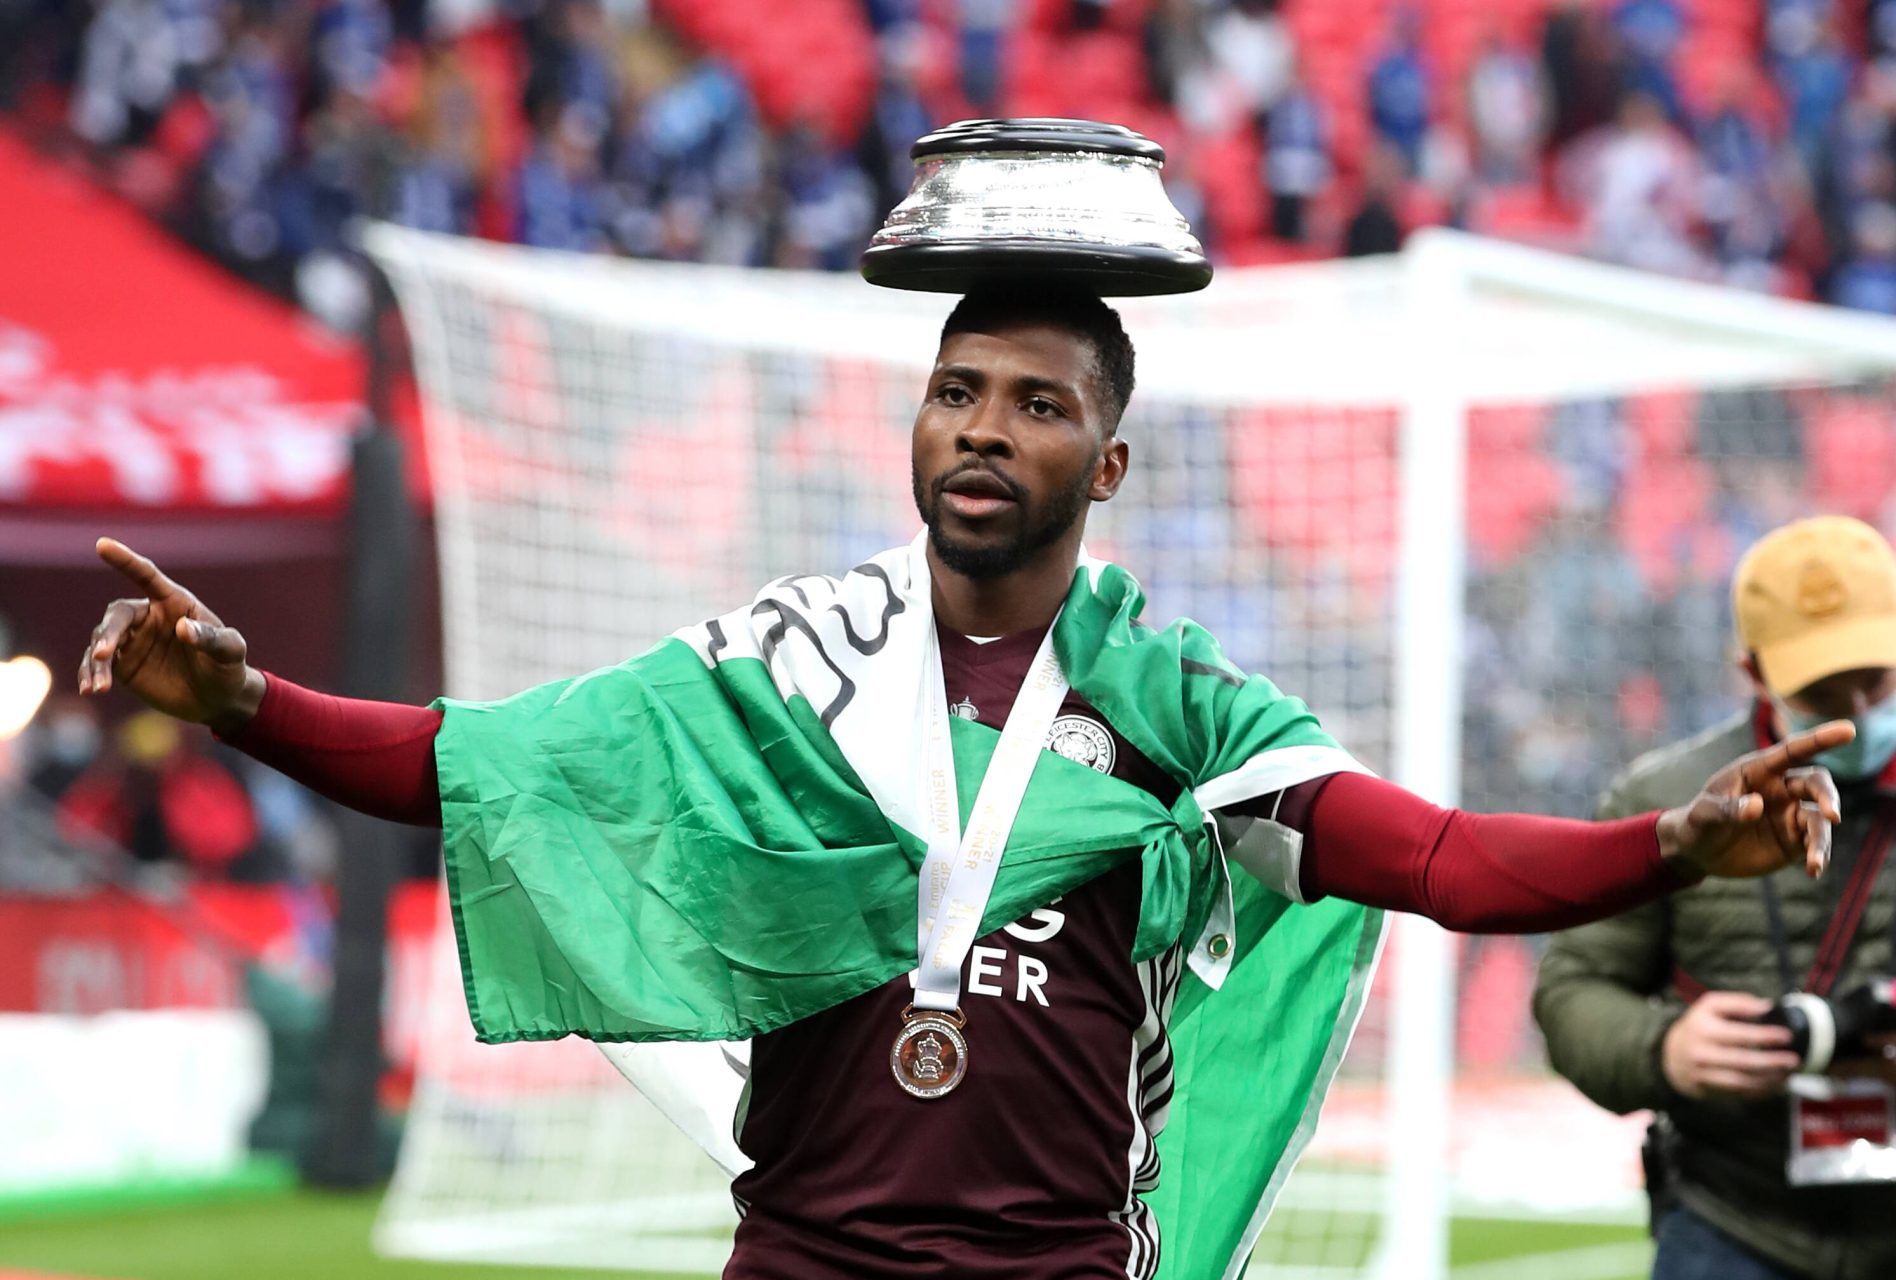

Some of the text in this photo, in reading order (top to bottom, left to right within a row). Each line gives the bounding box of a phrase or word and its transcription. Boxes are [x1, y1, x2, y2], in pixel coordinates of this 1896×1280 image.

[1045, 722, 1108, 759] LEICESTER CITY
[931, 768, 950, 834] WINNER
